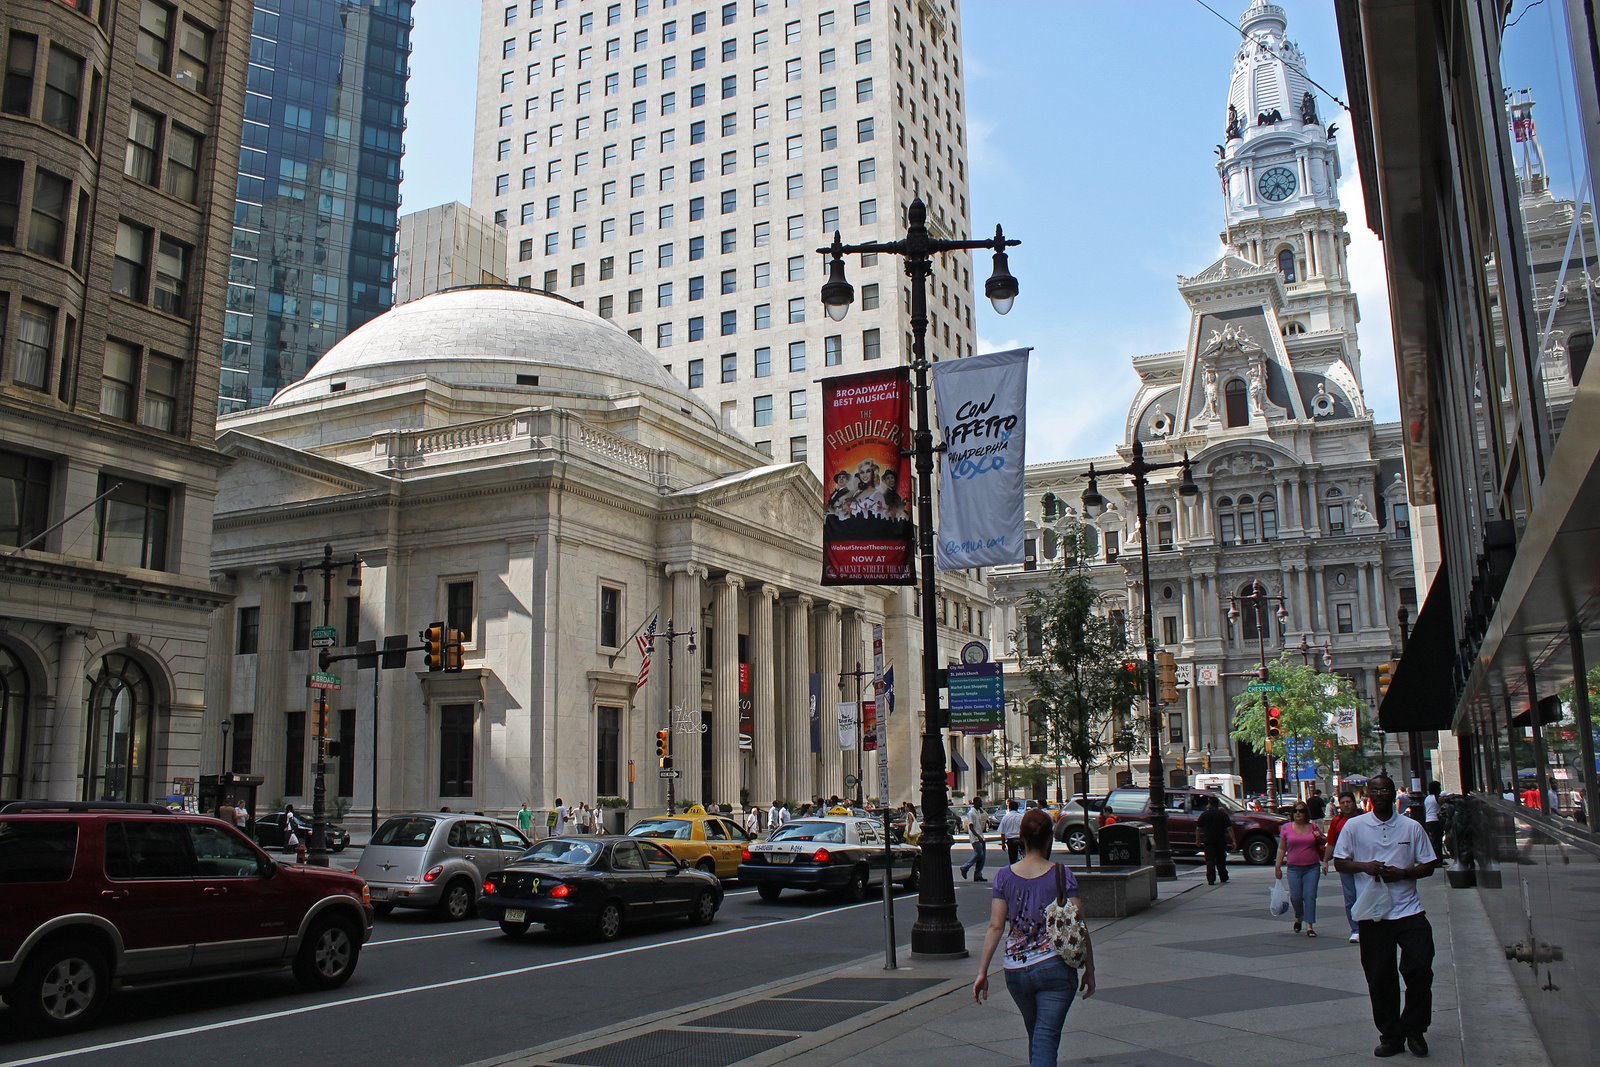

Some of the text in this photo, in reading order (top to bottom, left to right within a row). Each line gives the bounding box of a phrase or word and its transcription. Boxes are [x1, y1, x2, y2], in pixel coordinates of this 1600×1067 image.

[836, 381, 896, 398] BROADWAY'S
[833, 391, 899, 408] BEST MUSICAL!
[956, 393, 996, 421] CON
[860, 409, 872, 418] THE
[826, 420, 904, 450] PRODUCERS
[944, 414, 1018, 448] AFFETTO
[948, 440, 1008, 464] PHILADELPHIA
[830, 544, 906, 552] WalnutStreetTheatre.org
[862, 564, 884, 574] STREET
[316, 676, 334, 684] BROAD
